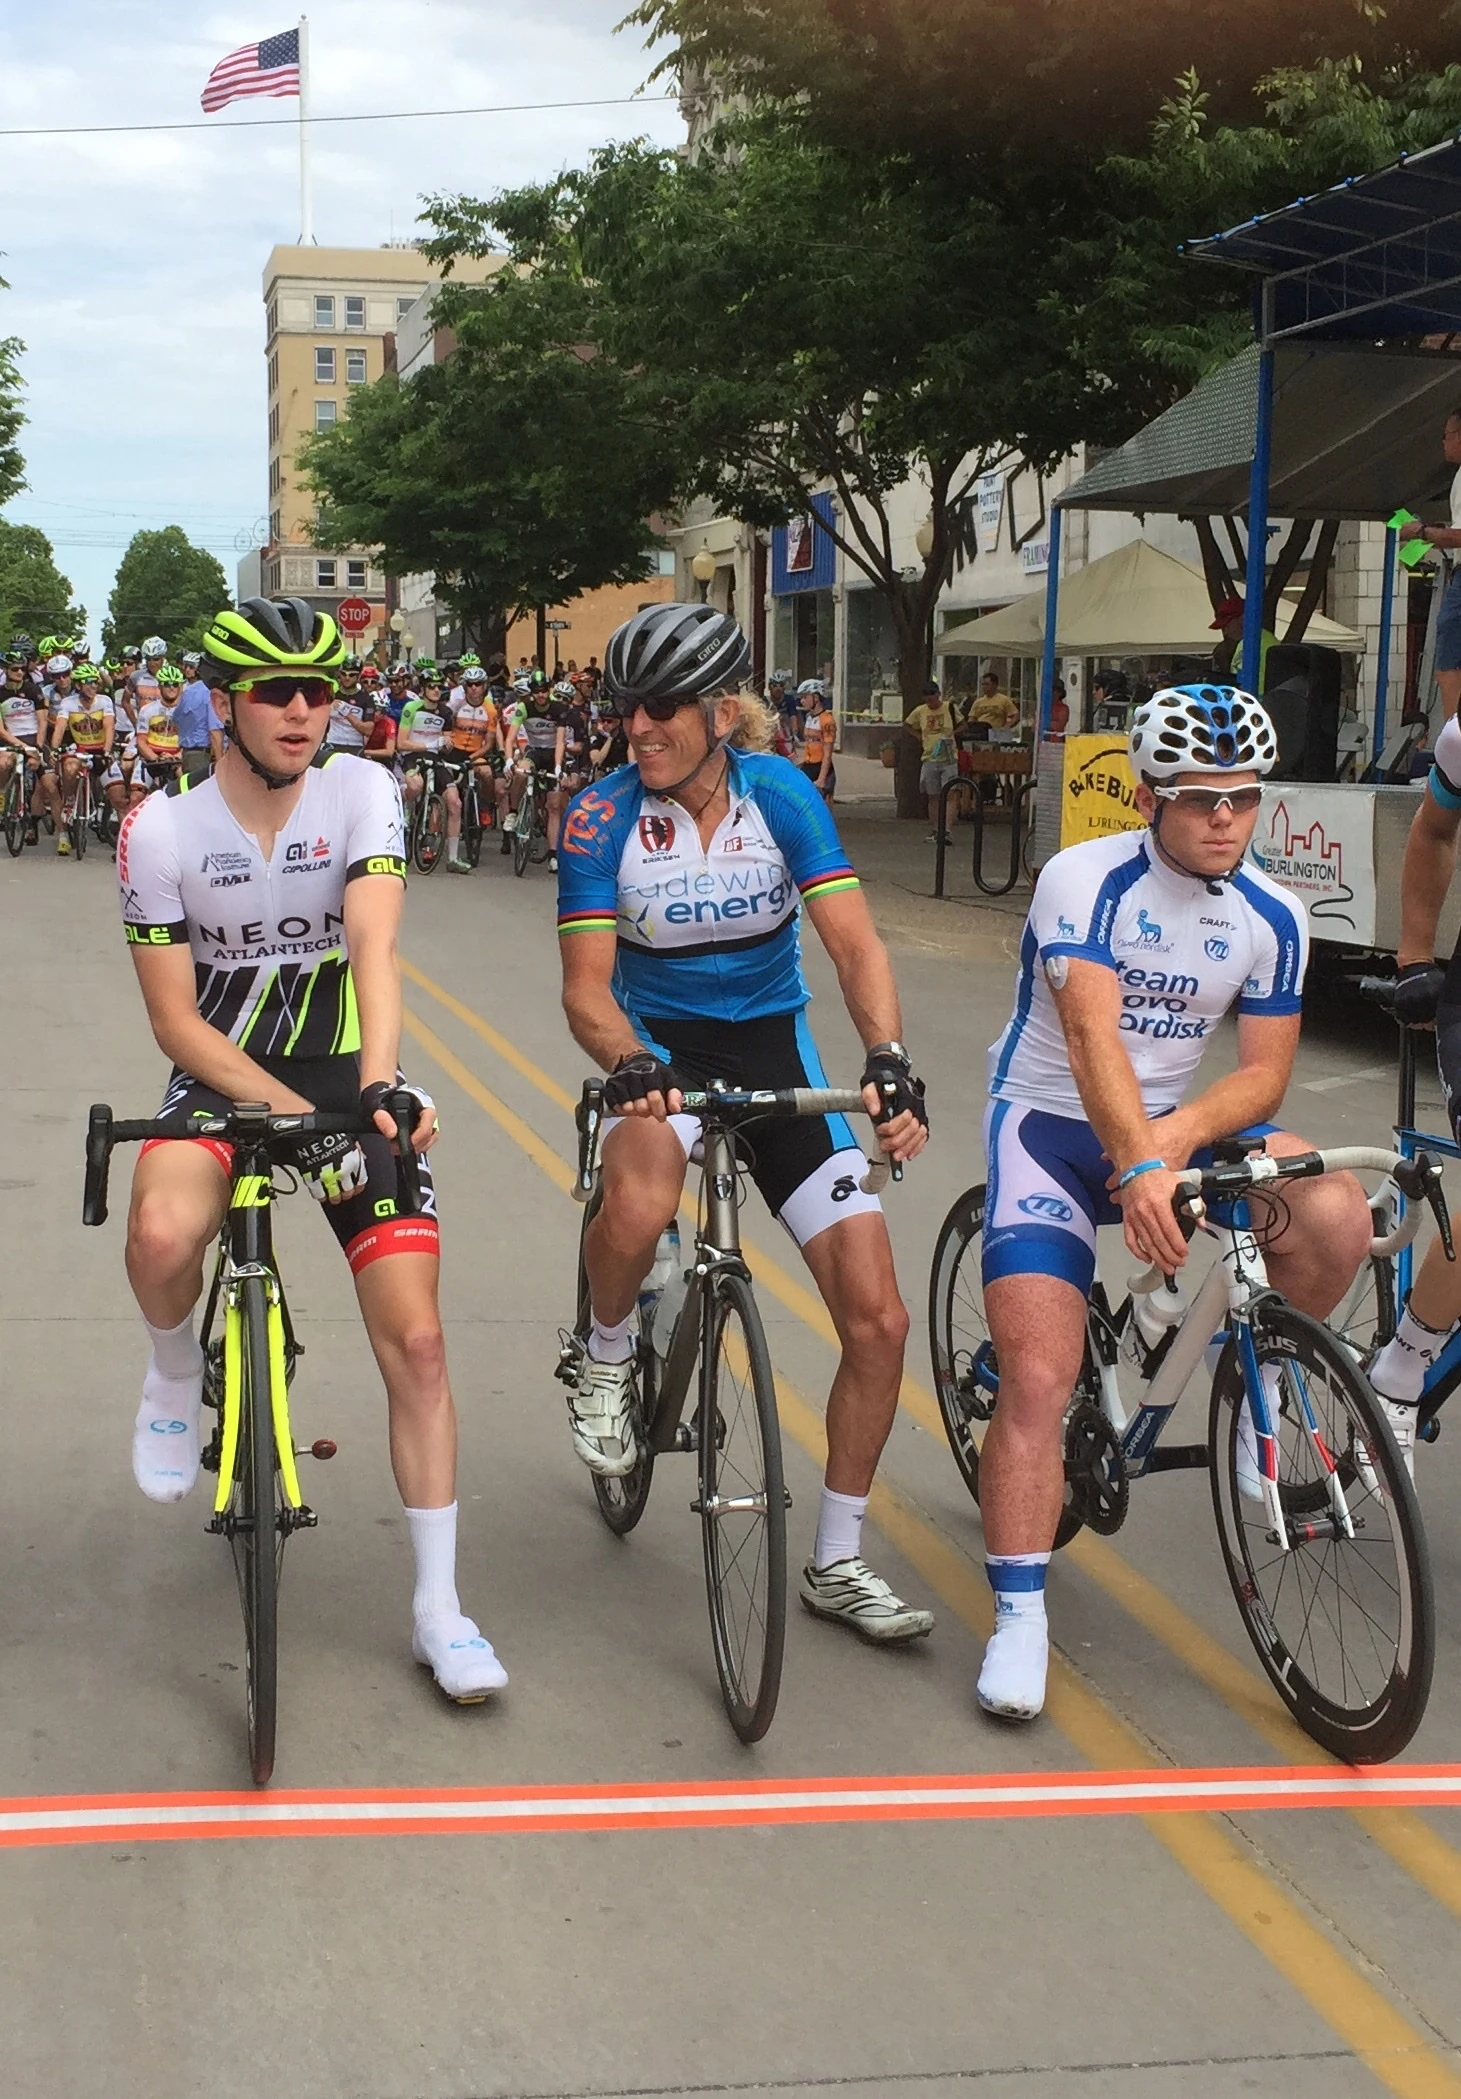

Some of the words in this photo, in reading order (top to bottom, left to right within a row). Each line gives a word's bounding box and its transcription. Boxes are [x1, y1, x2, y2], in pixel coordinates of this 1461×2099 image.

[340, 608, 370, 621] STOP
[697, 637, 721, 662] GIRO
[282, 859, 332, 874] CIPOLLINI
[1265, 858, 1337, 881] BURLINGTON
[664, 878, 794, 925] energy
[199, 905, 345, 946] NEON
[1199, 916, 1231, 929] CRAFT
[213, 934, 342, 960] ATLANTECH
[1116, 960, 1199, 997] team
[1122, 994, 1188, 1013] ovo
[1118, 1013, 1210, 1040] ordisk
[1124, 1411, 1156, 1458] ORBEA
